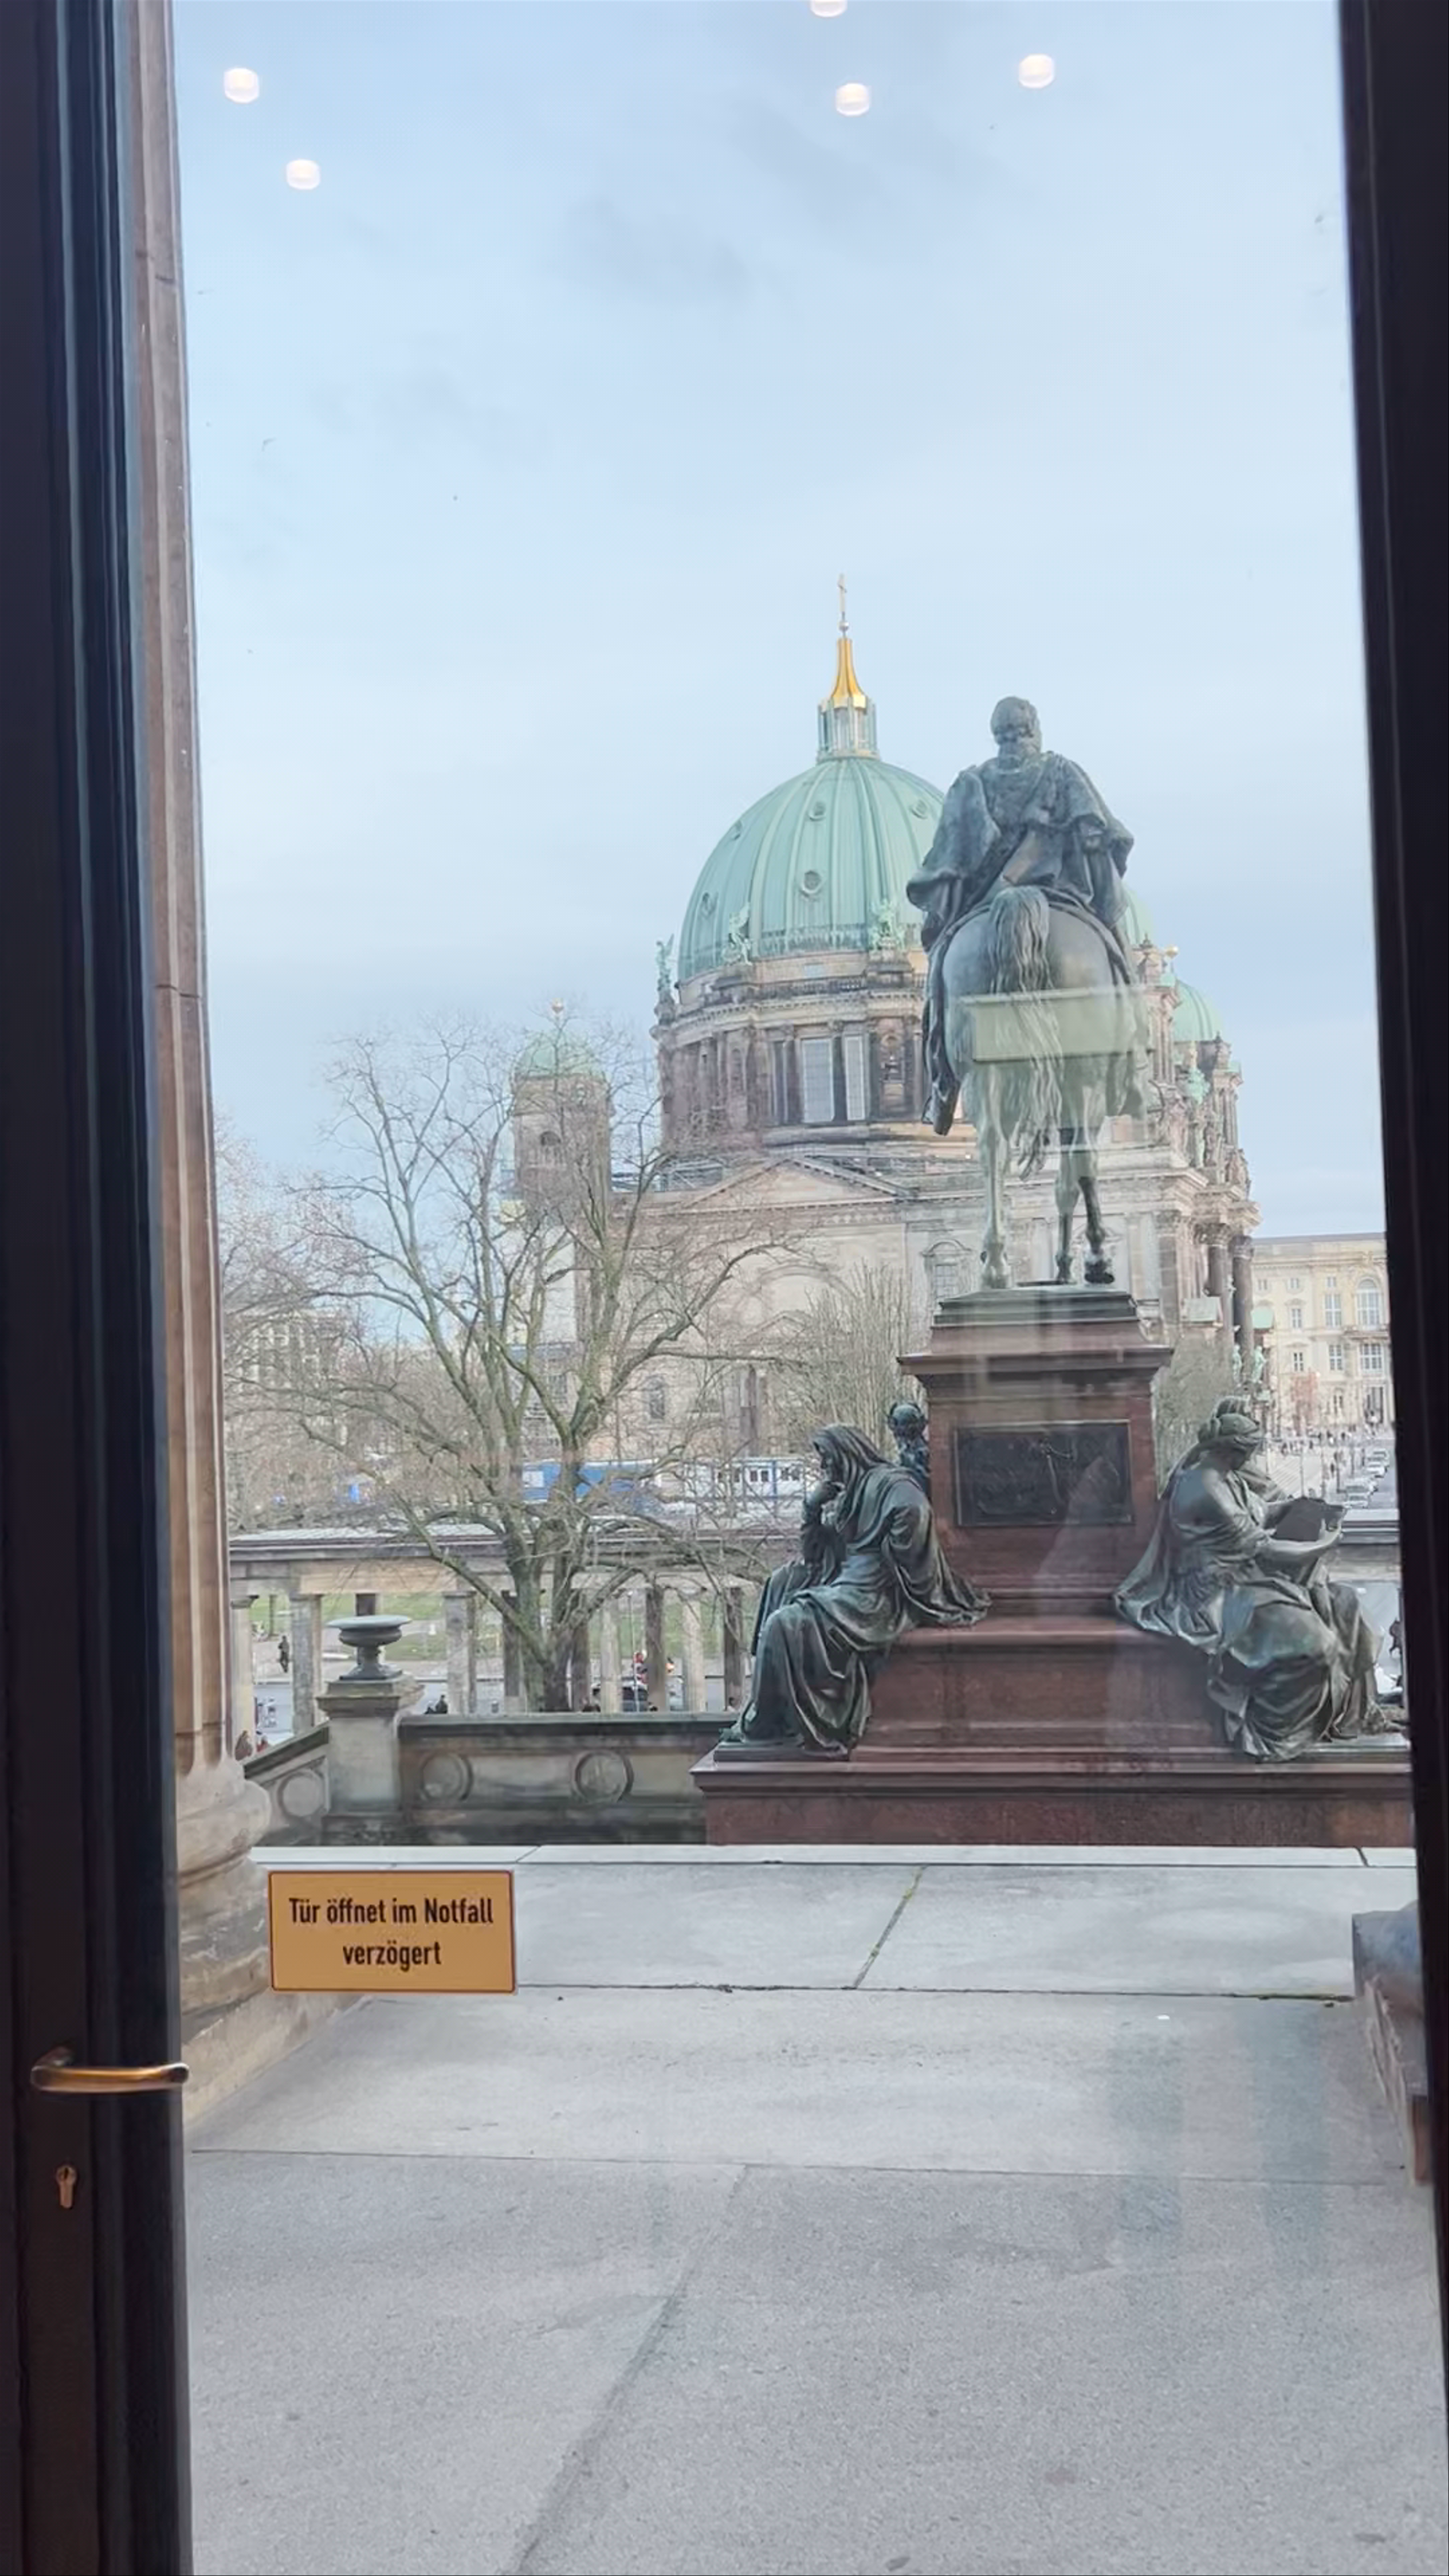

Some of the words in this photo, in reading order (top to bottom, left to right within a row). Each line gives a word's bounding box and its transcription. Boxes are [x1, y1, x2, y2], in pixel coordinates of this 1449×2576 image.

[289, 1898, 320, 1923] Tür
[326, 1898, 386, 1924] öffnet
[392, 1898, 417, 1923] im
[425, 1898, 493, 1923] Notfall
[343, 1940, 441, 1972] verzögert
